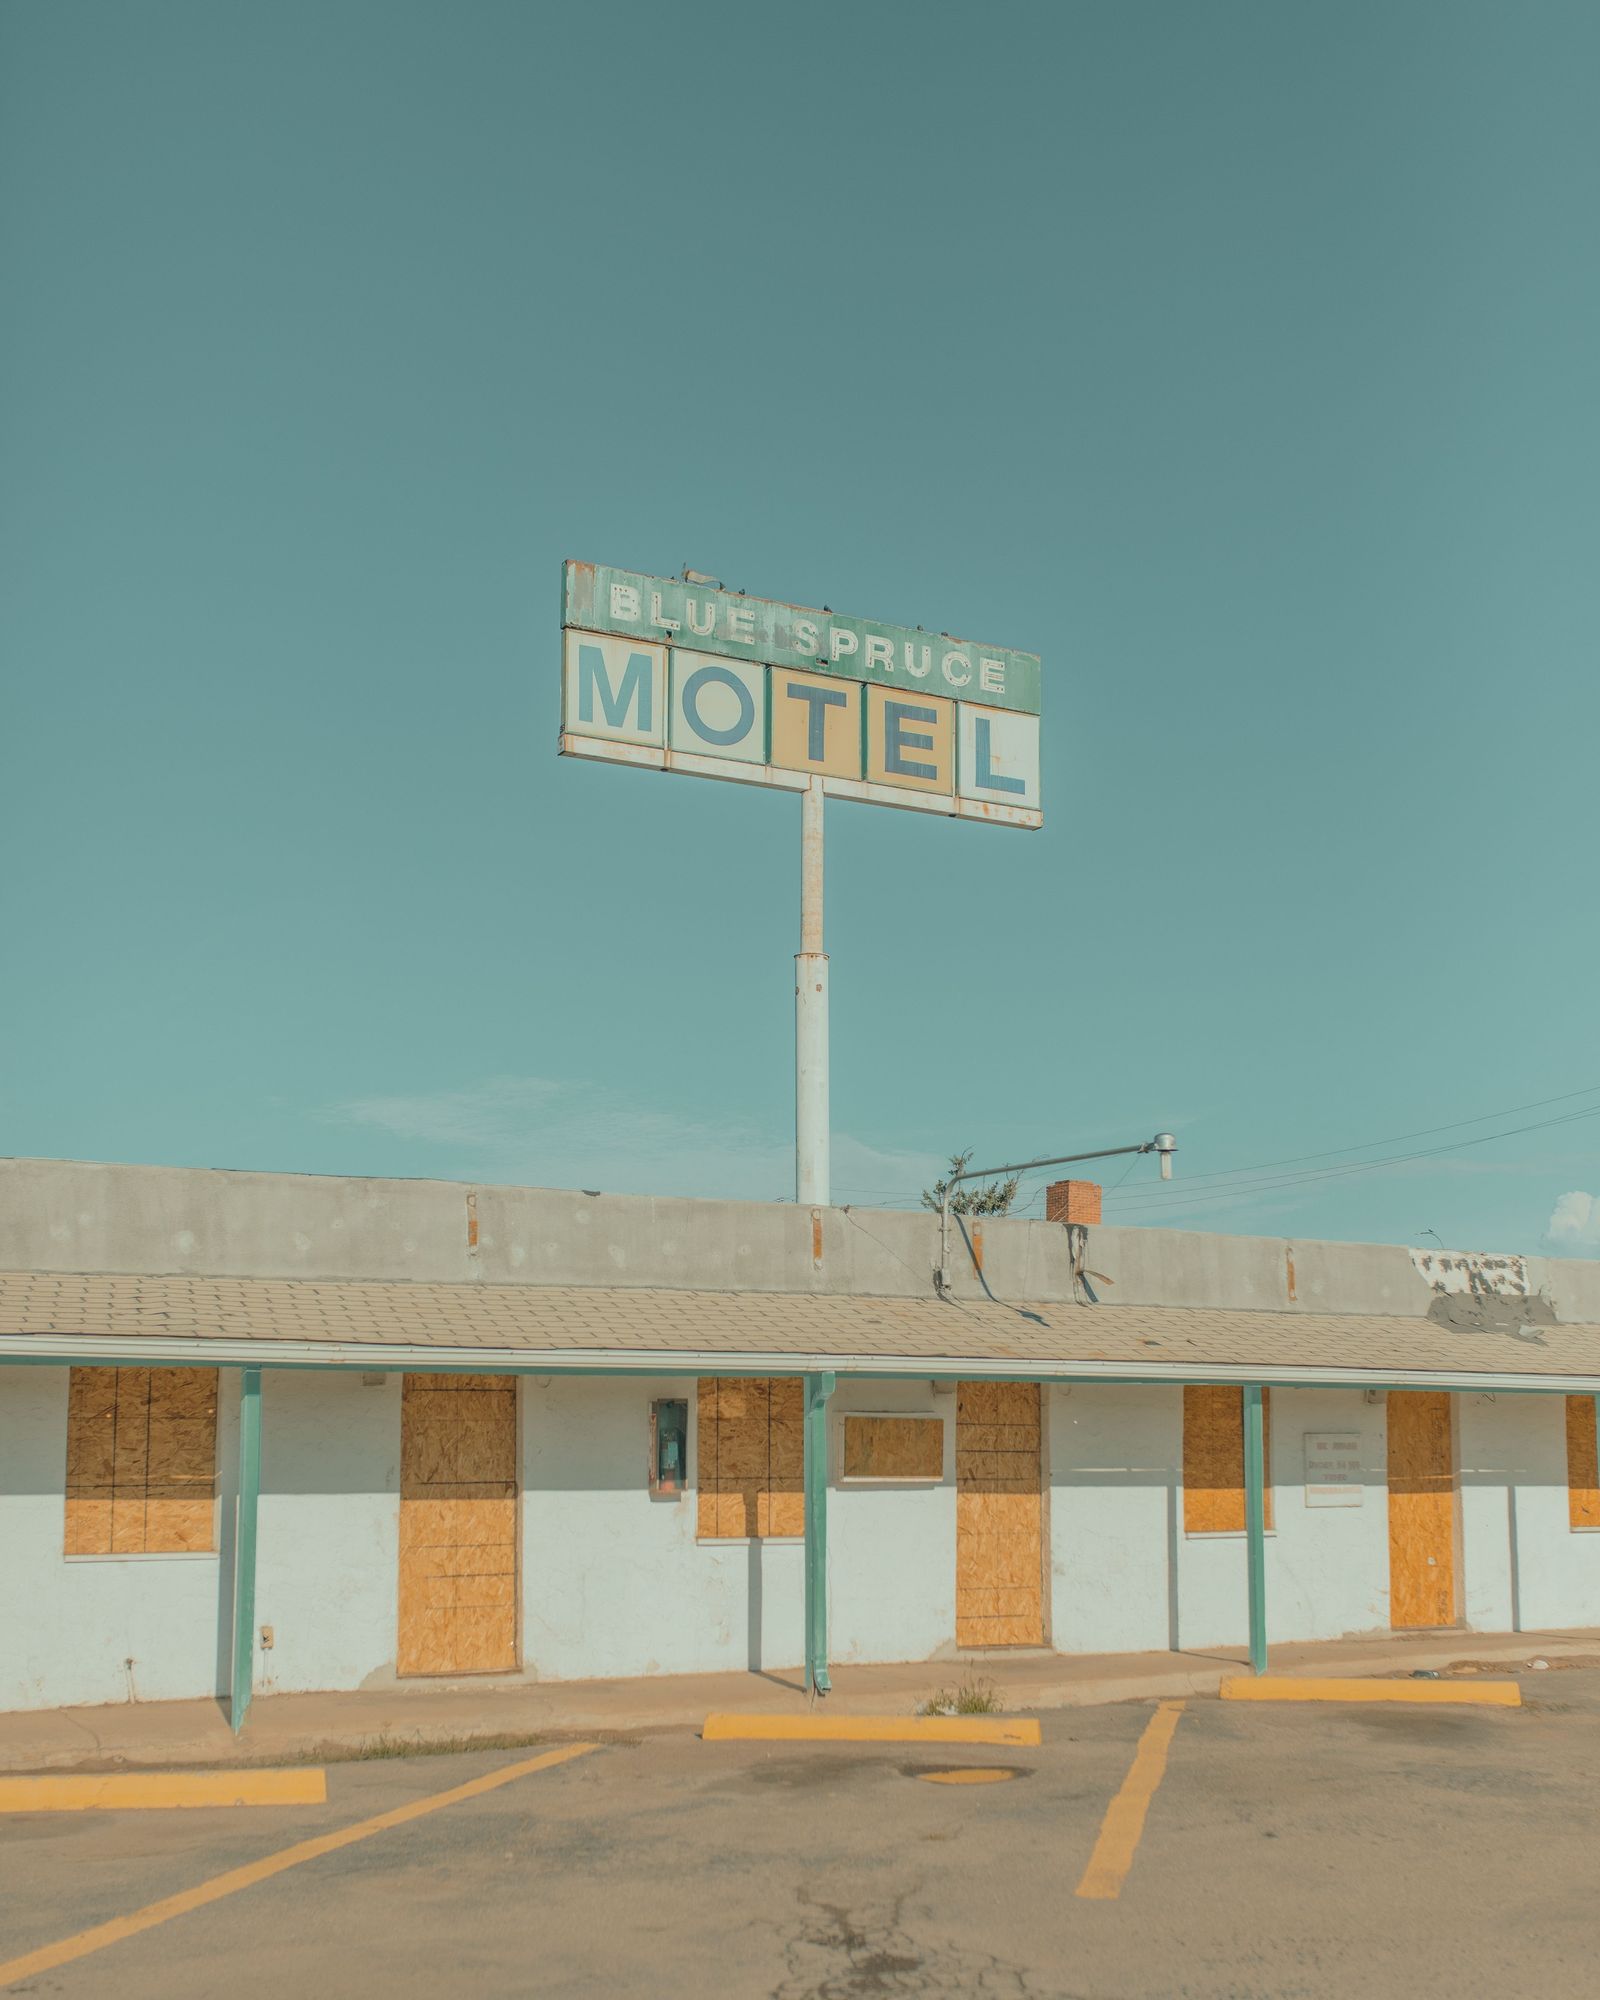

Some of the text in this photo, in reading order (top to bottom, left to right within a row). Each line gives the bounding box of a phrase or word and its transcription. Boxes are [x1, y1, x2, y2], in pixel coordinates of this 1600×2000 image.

[610, 583, 1006, 694] BLUE SPRUCE
[578, 645, 1026, 796] MOTEL
